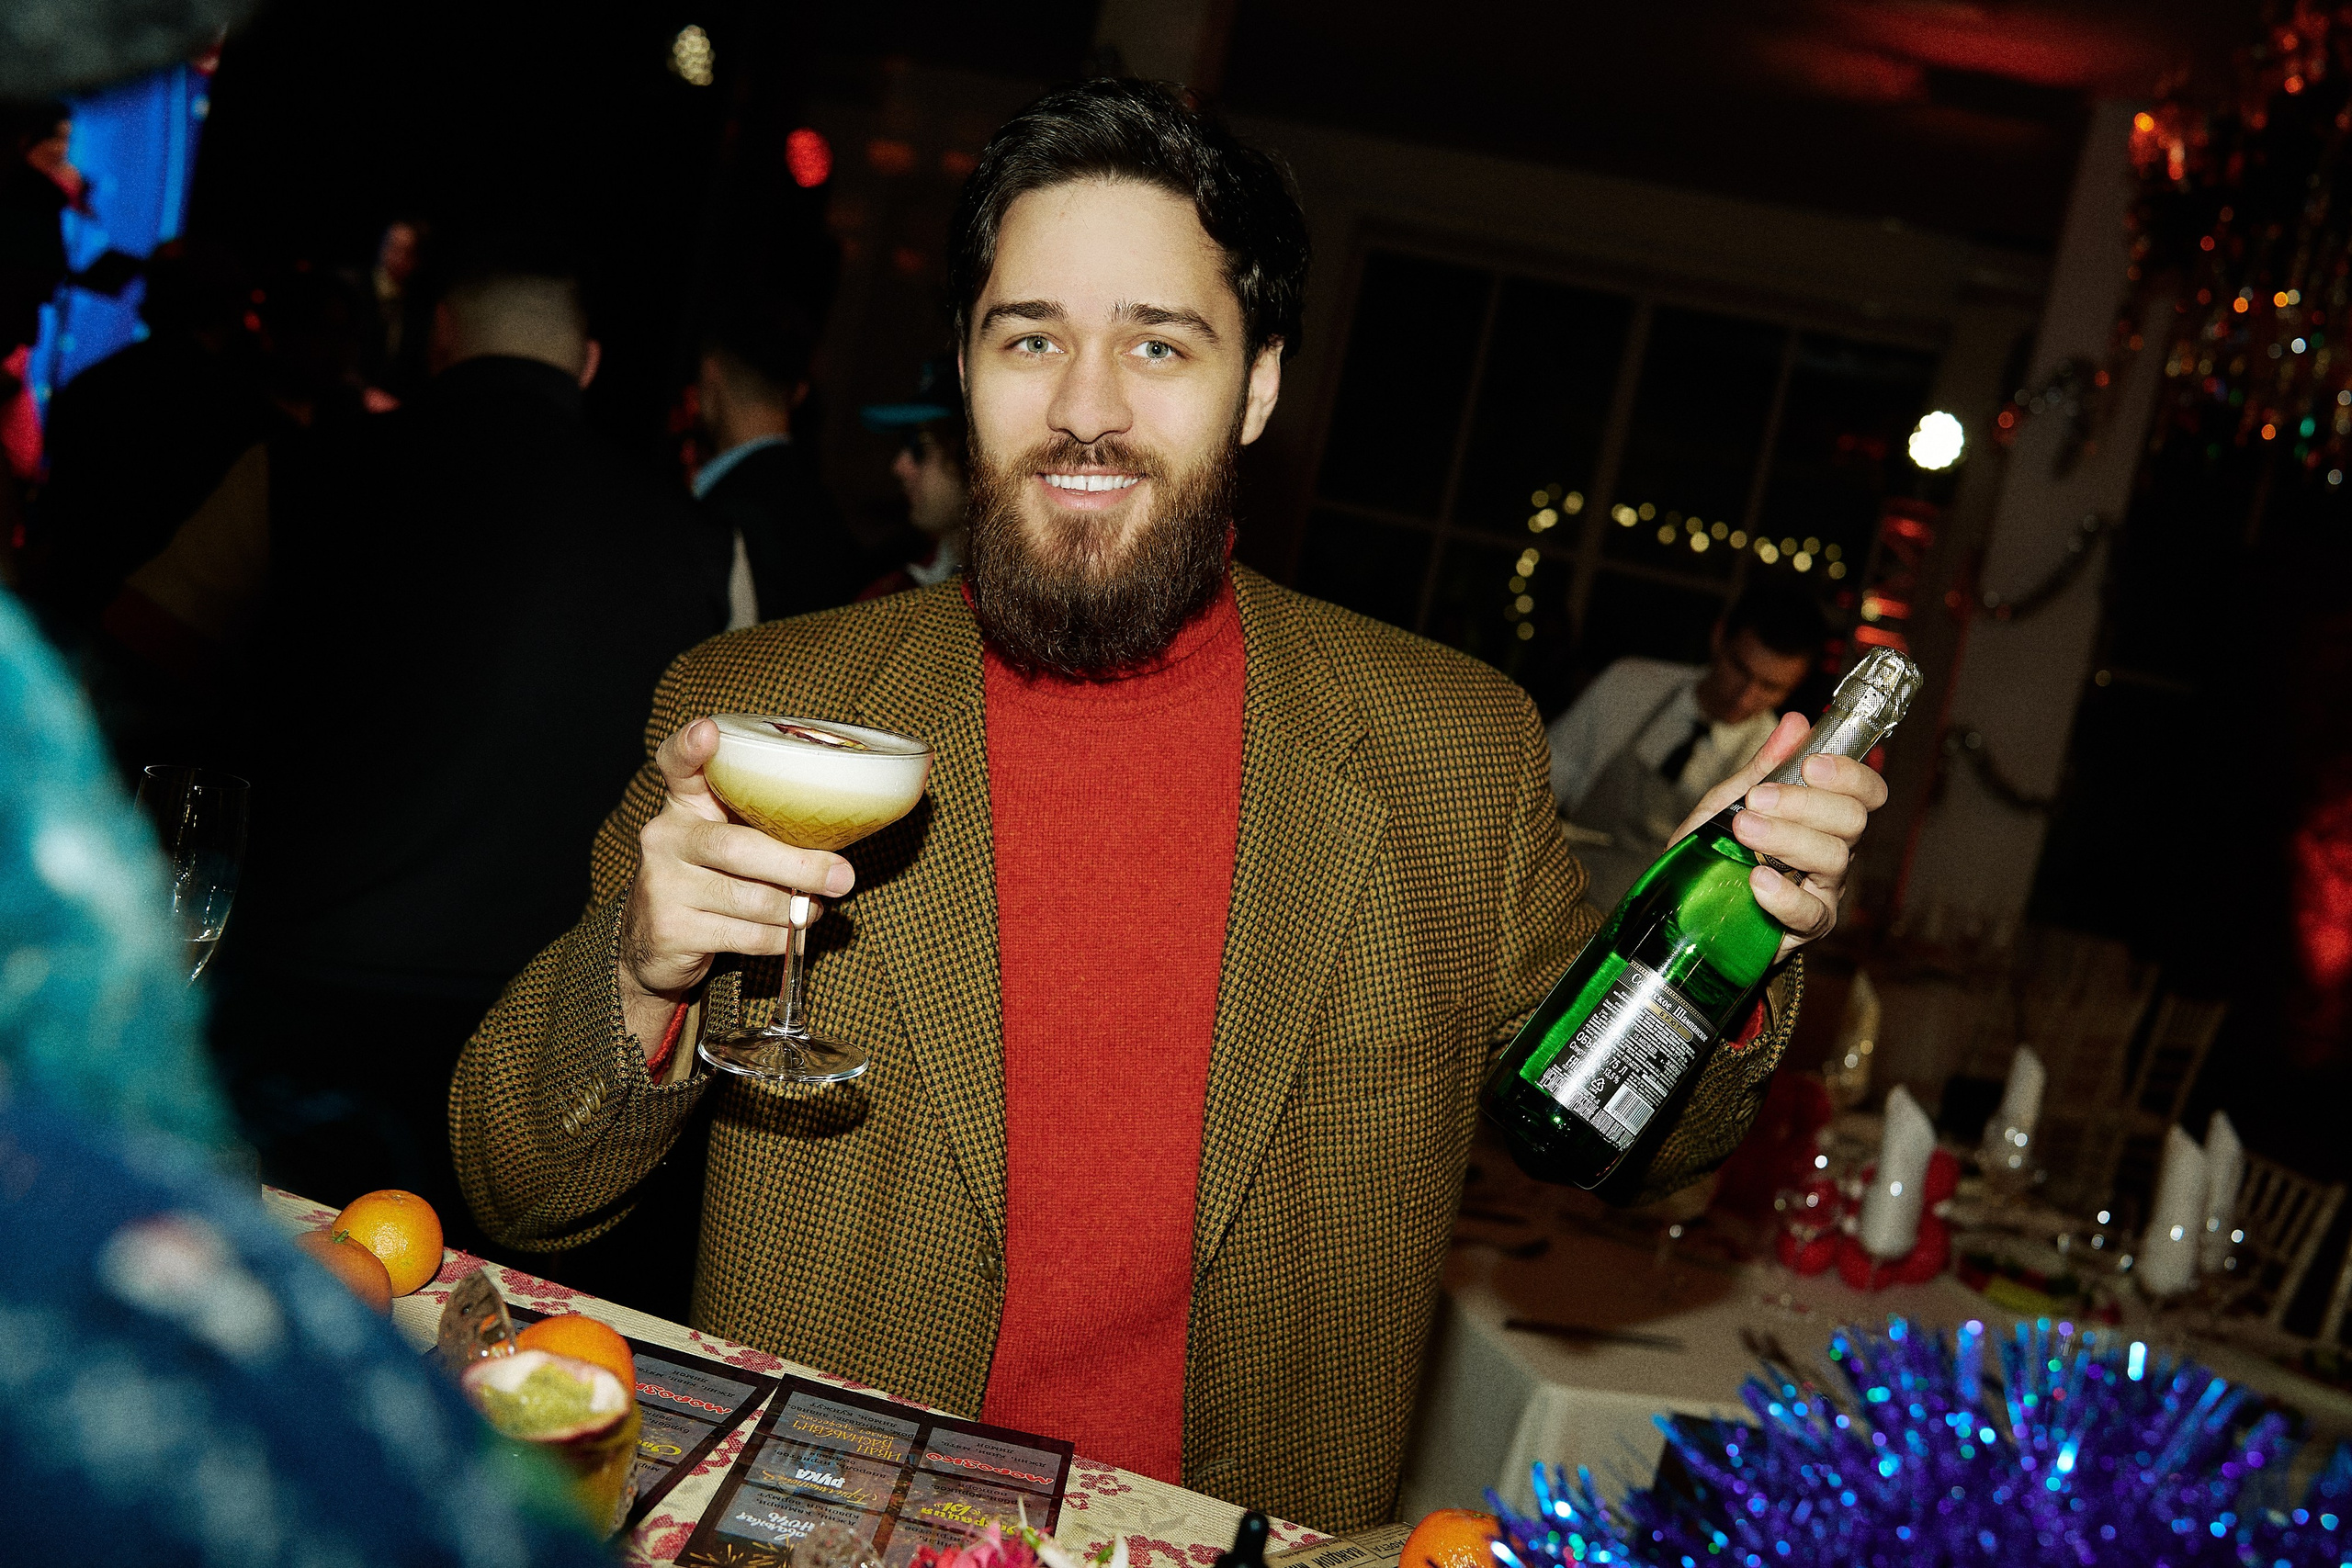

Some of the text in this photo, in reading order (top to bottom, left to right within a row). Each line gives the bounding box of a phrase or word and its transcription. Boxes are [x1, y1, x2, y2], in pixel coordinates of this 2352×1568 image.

[1659, 1011, 1680, 1029] БРЮТ
[1672, 1005, 1707, 1042] Шампанское
[1568, 1041, 1587, 1057] Спирт
[1575, 1031, 1603, 1055] ОБЪЕ
[672, 1371, 707, 1382] лимон
[634, 1382, 731, 1414] МОРОЗК
[809, 1403, 853, 1416] кунжут
[792, 1419, 892, 1450] ВАСИЛЬЕВИЧ
[976, 1442, 1013, 1453] лимон
[795, 1468, 844, 1488] РУКА
